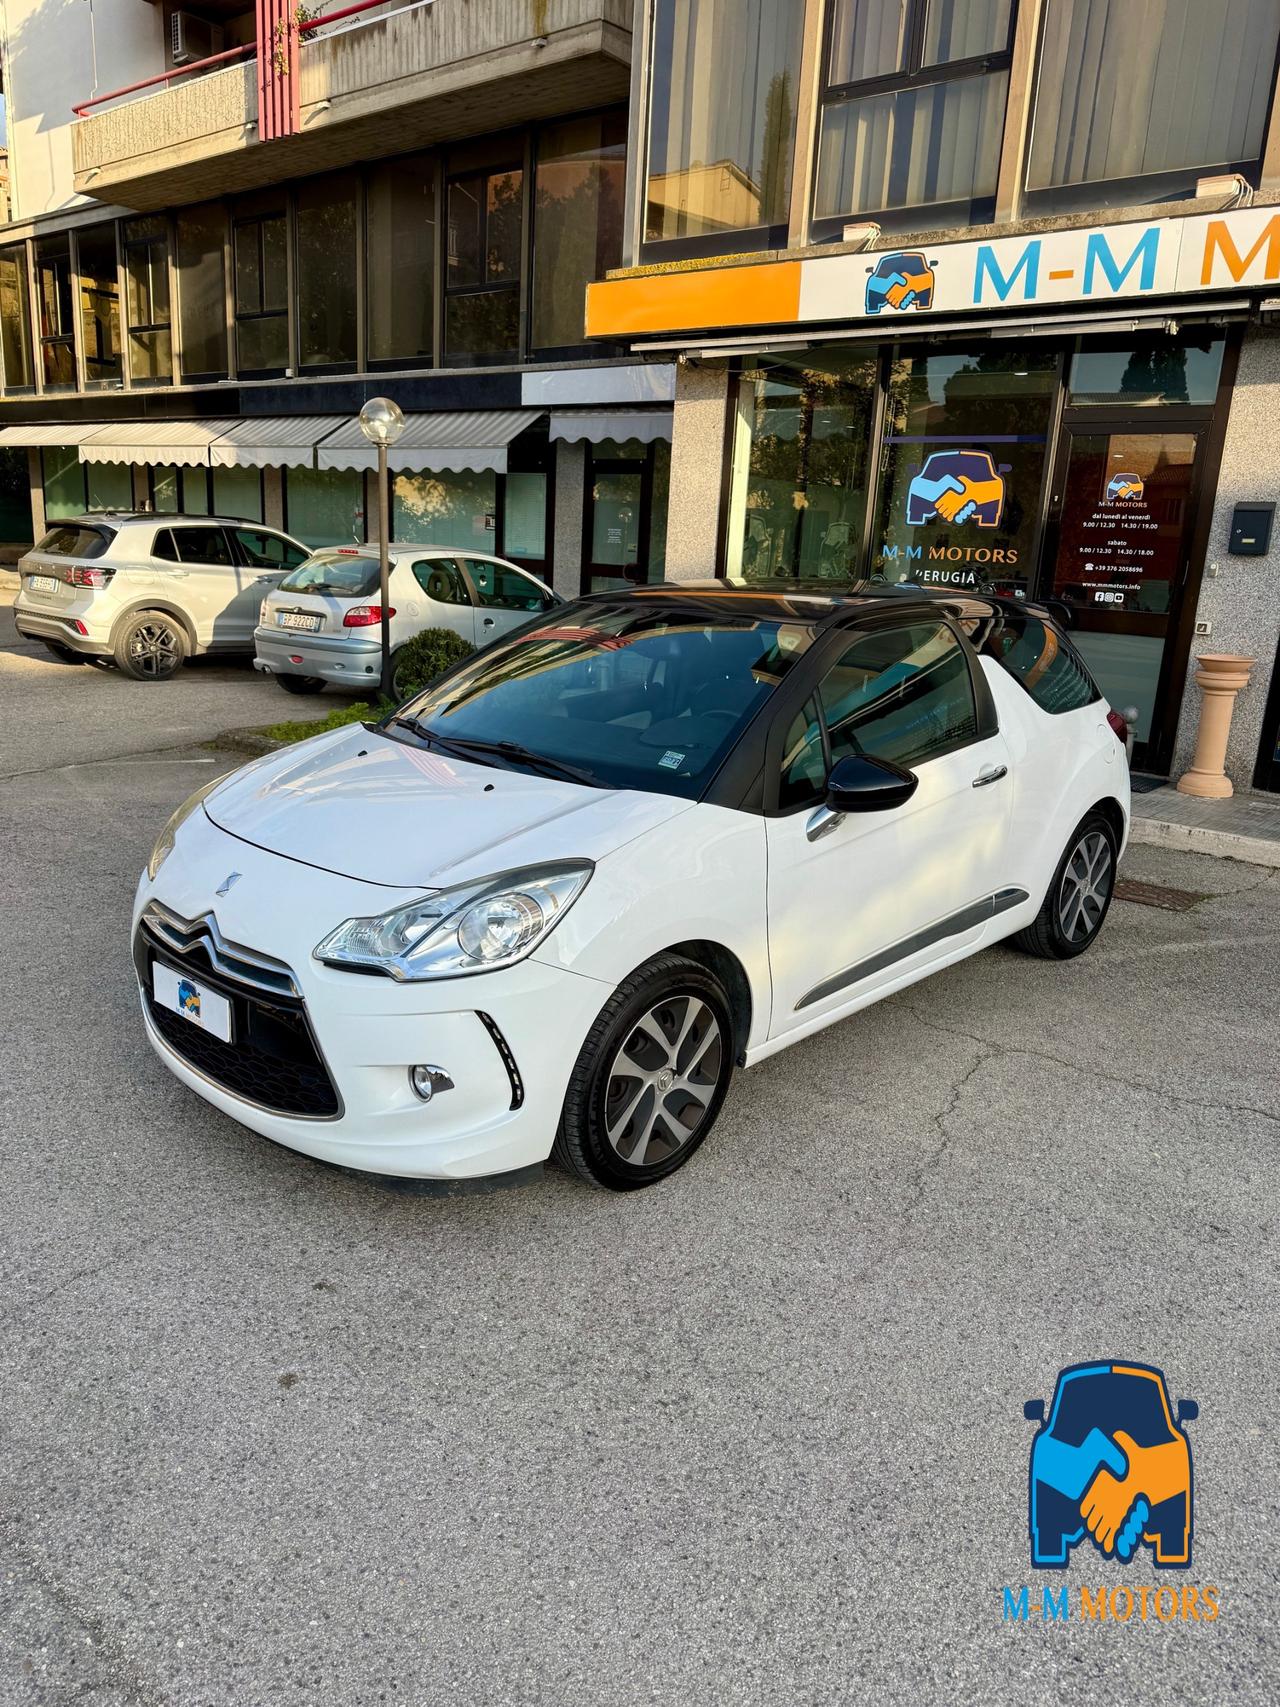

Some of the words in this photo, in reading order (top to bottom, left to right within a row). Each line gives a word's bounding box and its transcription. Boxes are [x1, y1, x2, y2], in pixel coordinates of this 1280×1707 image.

[973, 227, 1160, 303] M-M
[882, 544, 922, 560] M-M
[928, 546, 1018, 564] MOTORS
[1082, 582, 1141, 590] www.mmmotors.info
